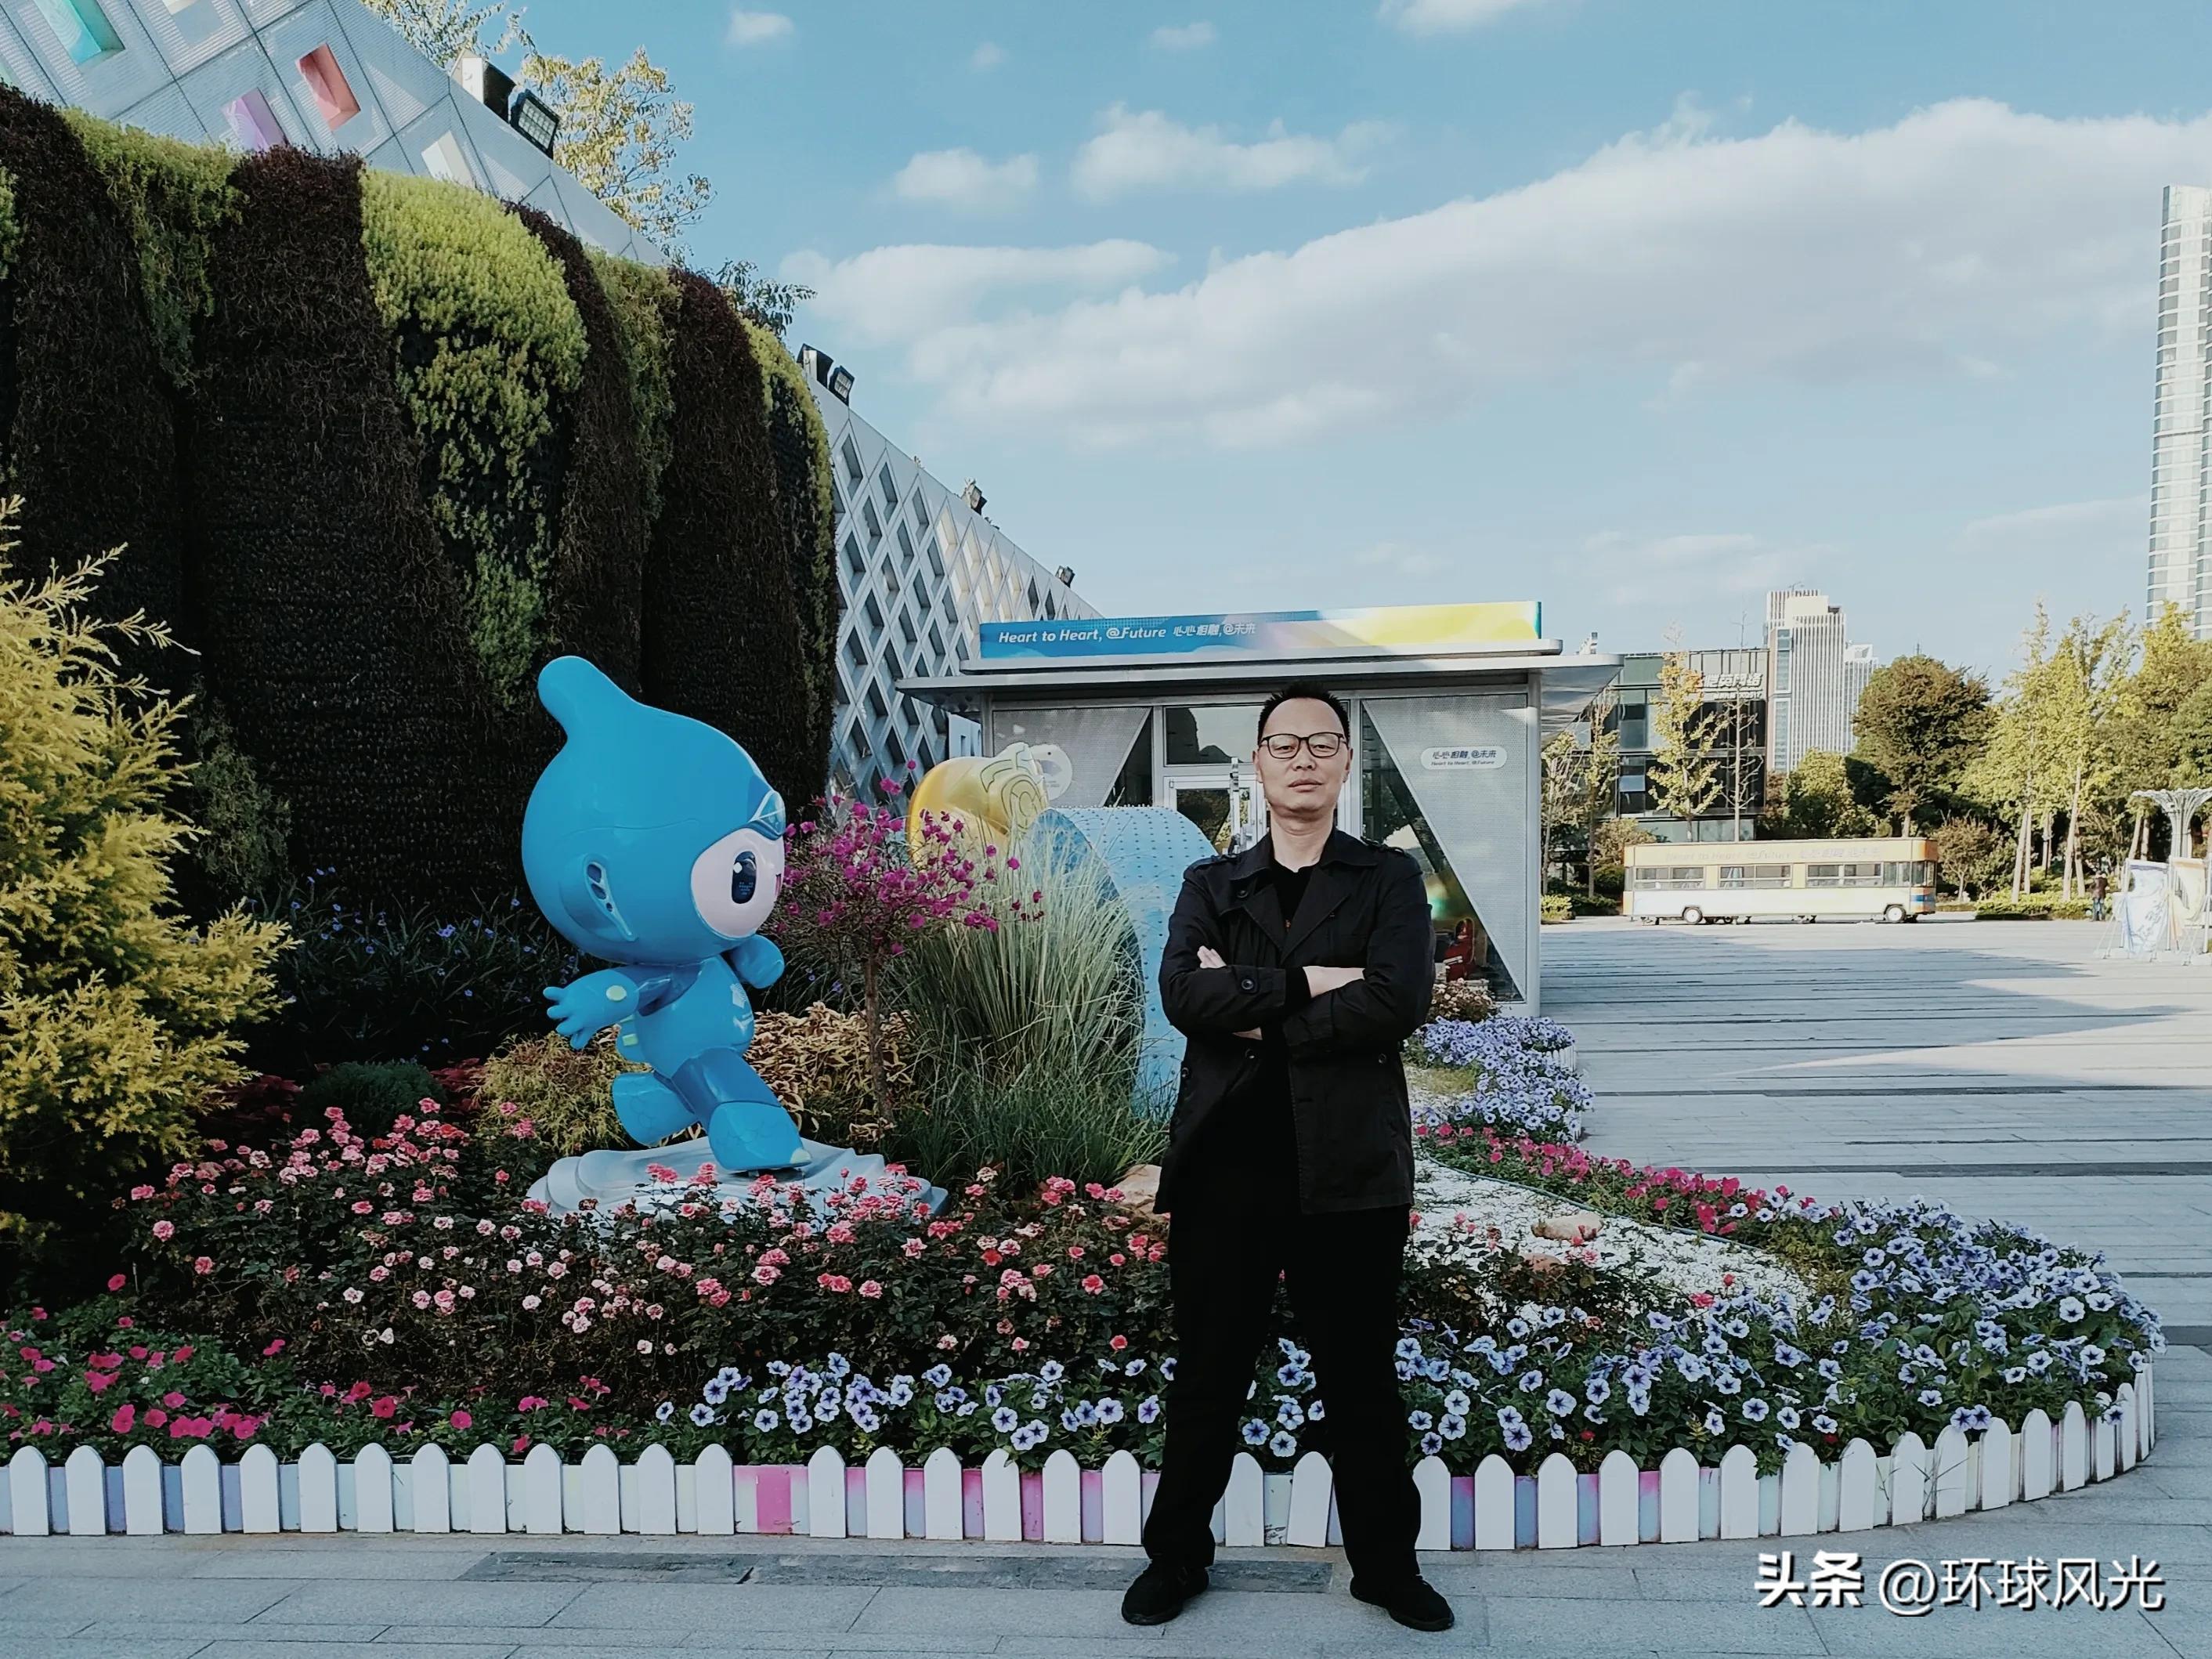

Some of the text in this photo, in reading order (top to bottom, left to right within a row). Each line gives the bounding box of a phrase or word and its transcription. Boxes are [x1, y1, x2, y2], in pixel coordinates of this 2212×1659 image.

[999, 627, 1167, 643] Heart to Heart, @Future
